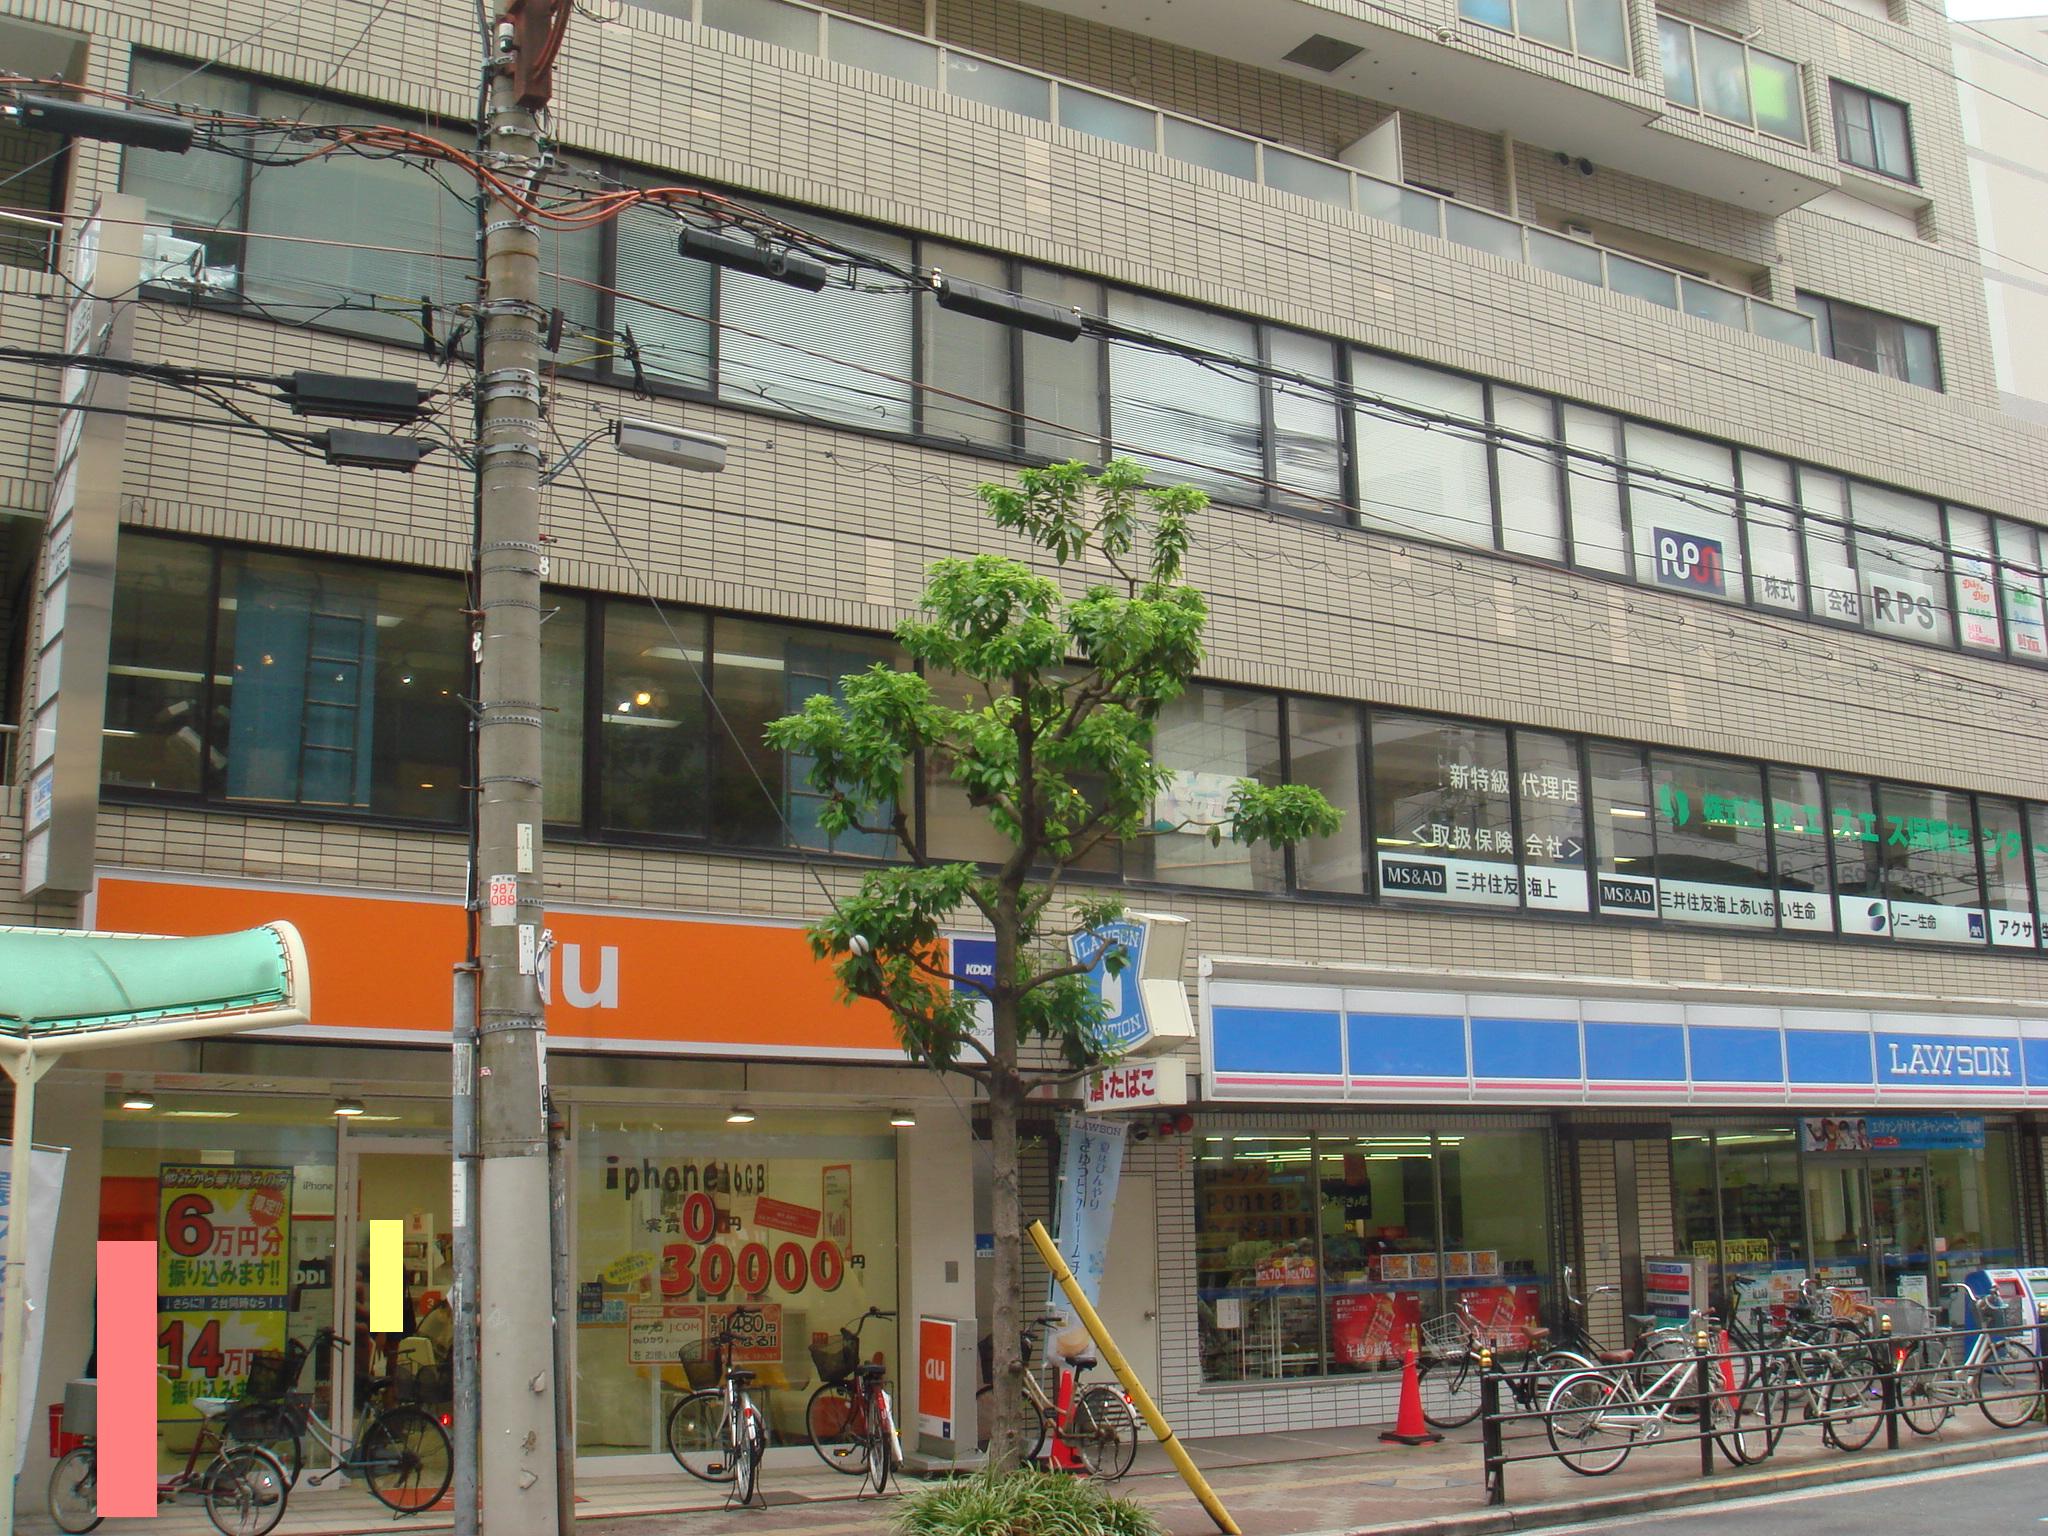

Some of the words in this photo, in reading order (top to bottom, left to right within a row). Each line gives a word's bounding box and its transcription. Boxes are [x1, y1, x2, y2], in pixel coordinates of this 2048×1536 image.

[1764, 573, 1796, 603] 株式
[1827, 587, 1858, 617] 会社
[1873, 585, 1935, 630] RPS
[1387, 866, 1443, 887] MS&AD
[491, 883, 515, 895] 987
[1603, 886, 1651, 905] MS&AD
[491, 894, 515, 906] 088
[965, 963, 992, 976] KDDI
[1888, 1043, 2012, 1077] LAWSON
[303, 1180, 334, 1191] iPhone
[605, 1155, 718, 1200] iphone
[925, 1357, 945, 1382] au
